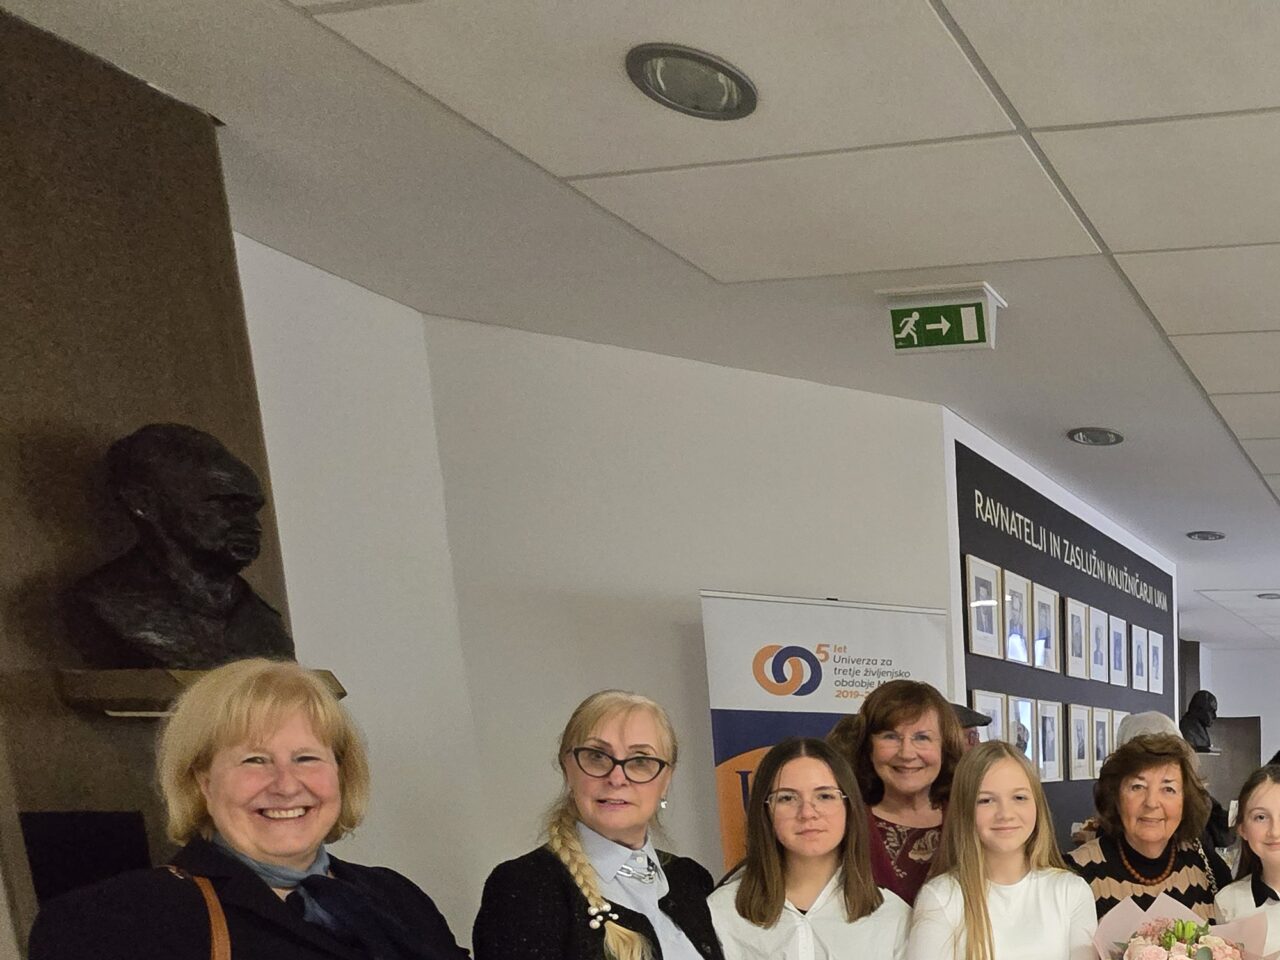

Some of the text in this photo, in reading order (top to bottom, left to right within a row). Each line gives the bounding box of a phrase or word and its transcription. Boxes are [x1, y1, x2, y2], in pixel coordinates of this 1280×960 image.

[975, 488, 1168, 613] RAVNATELJI IN ZASLUŽNI KNJIŽNIČARJI UKM
[815, 644, 847, 662] 5 let
[833, 656, 878, 666] Univerza
[834, 667, 911, 679] tretje življenjsko
[834, 679, 875, 689] obdobje
